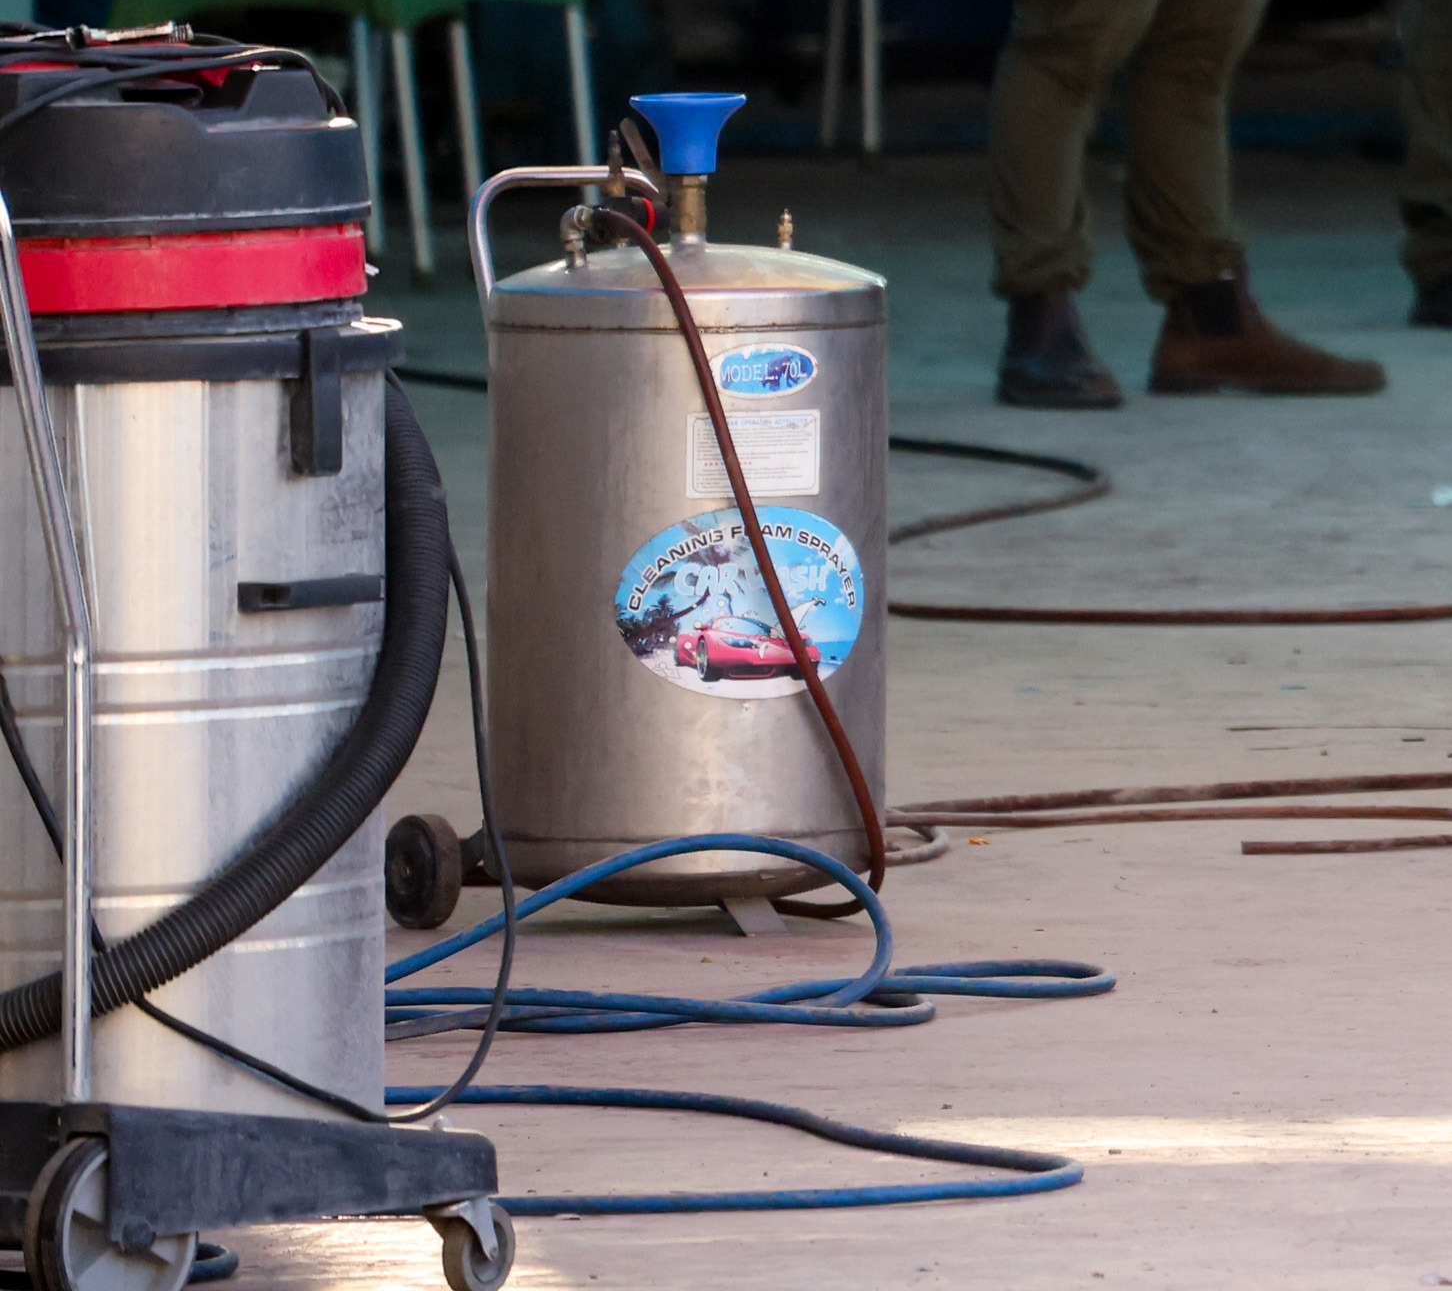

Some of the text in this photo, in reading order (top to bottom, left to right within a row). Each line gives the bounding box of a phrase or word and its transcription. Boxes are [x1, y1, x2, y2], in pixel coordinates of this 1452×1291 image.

[782, 360, 808, 379] 70L
[628, 524, 856, 611] CLEANING FAM SPRAYER
[674, 562, 739, 597] CAR
